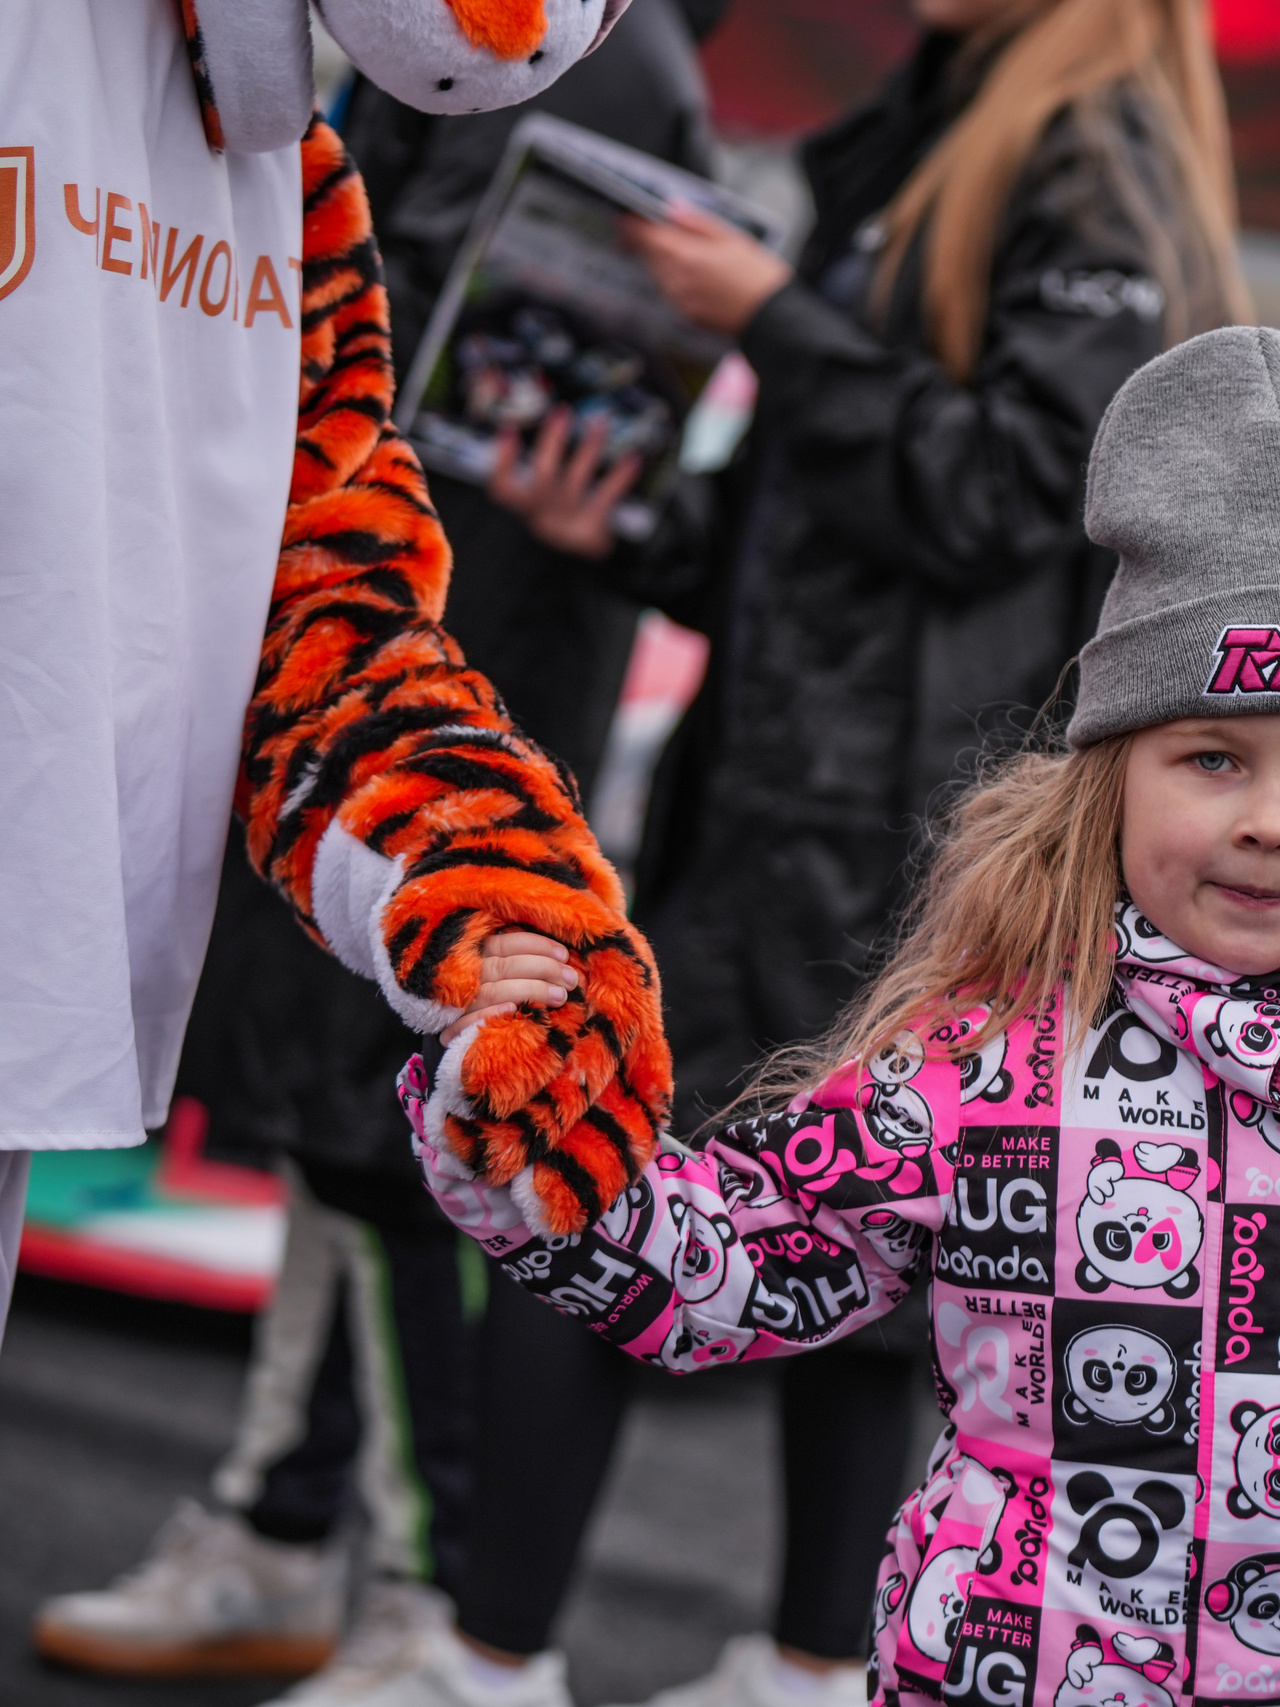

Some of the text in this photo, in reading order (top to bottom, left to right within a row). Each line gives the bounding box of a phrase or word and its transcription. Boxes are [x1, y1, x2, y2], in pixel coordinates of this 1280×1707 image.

[1119, 1106, 1206, 1131] WORLD
[1002, 1137, 1051, 1150] MAKE
[982, 1155, 1051, 1169] BETTER
[606, 1273, 654, 1324] WORLD
[1224, 1212, 1267, 1365] panda
[964, 1295, 1047, 1321] BETTER
[1029, 1322, 1047, 1405] WORLD
[1010, 1476, 1049, 1586] panda
[987, 1608, 1033, 1630] MAKE
[1099, 1595, 1180, 1625] WORLD
[963, 1622, 1032, 1648] BETTER
